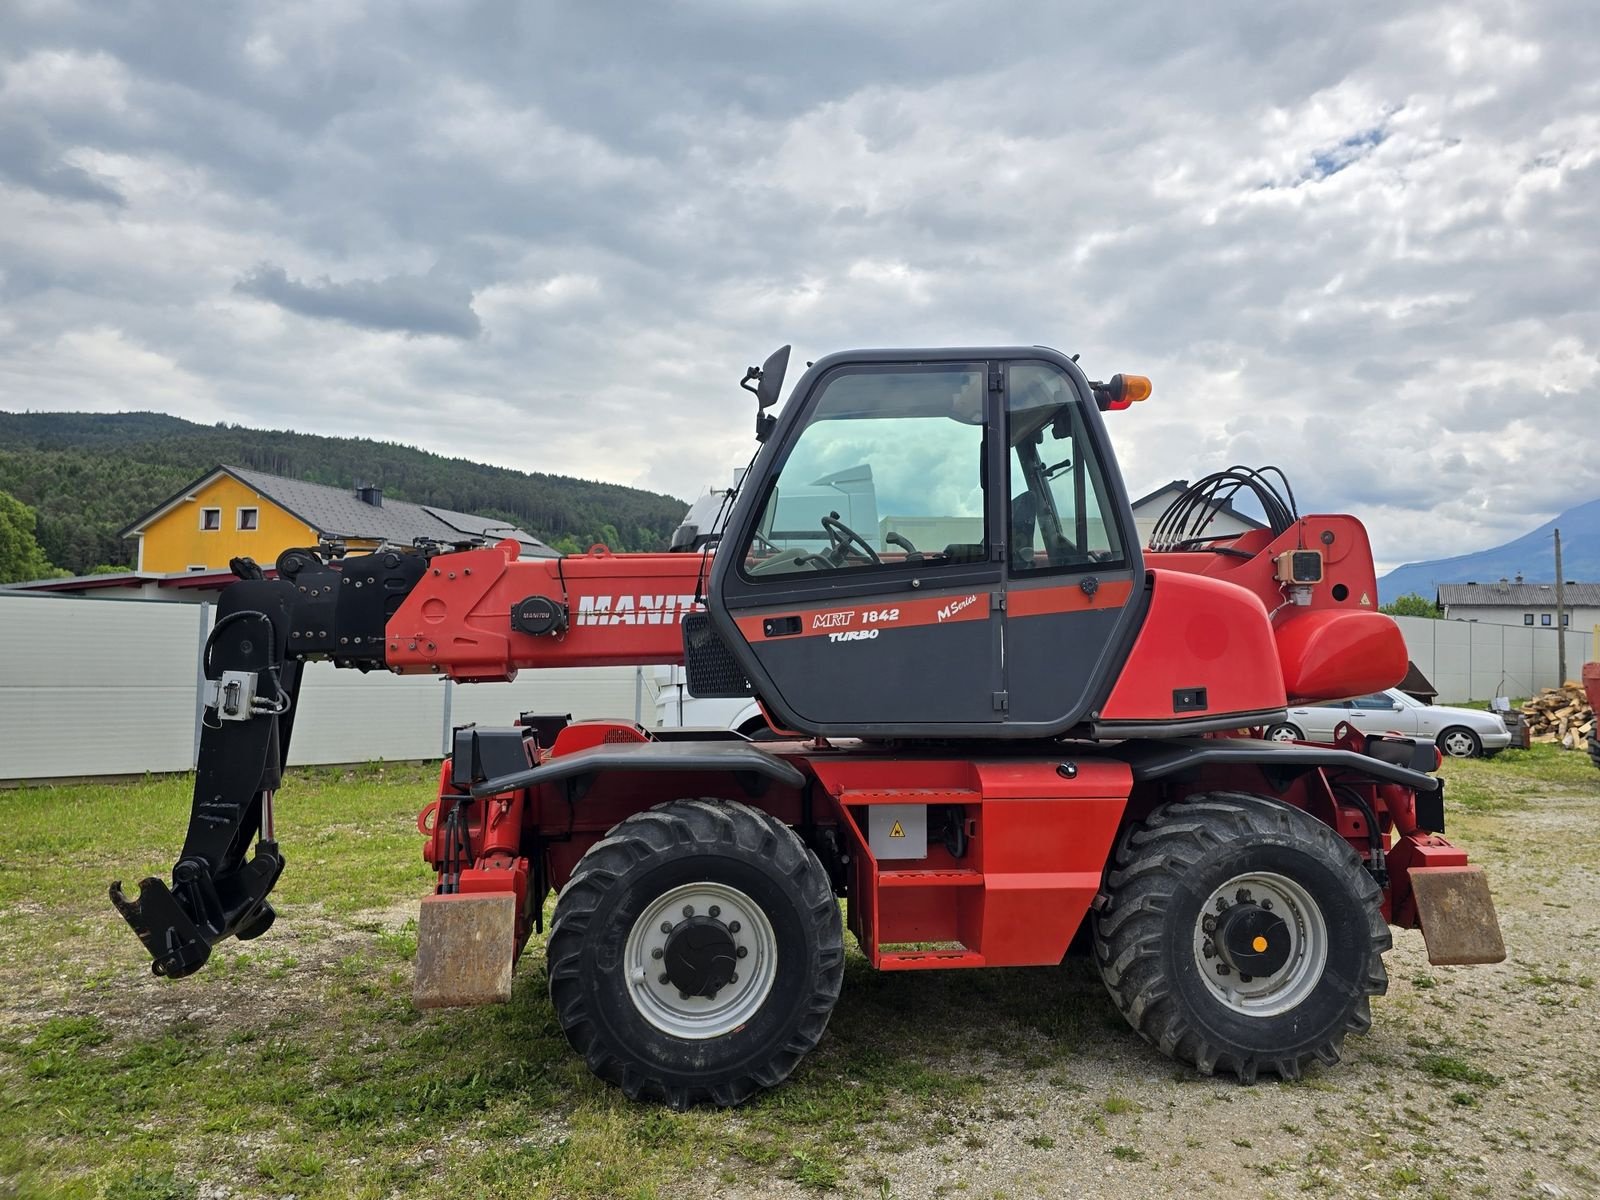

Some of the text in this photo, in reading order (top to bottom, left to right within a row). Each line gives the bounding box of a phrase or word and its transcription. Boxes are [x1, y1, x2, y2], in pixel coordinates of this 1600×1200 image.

[812, 608, 900, 628] MRT 1842
[828, 629, 879, 643] TURBO
